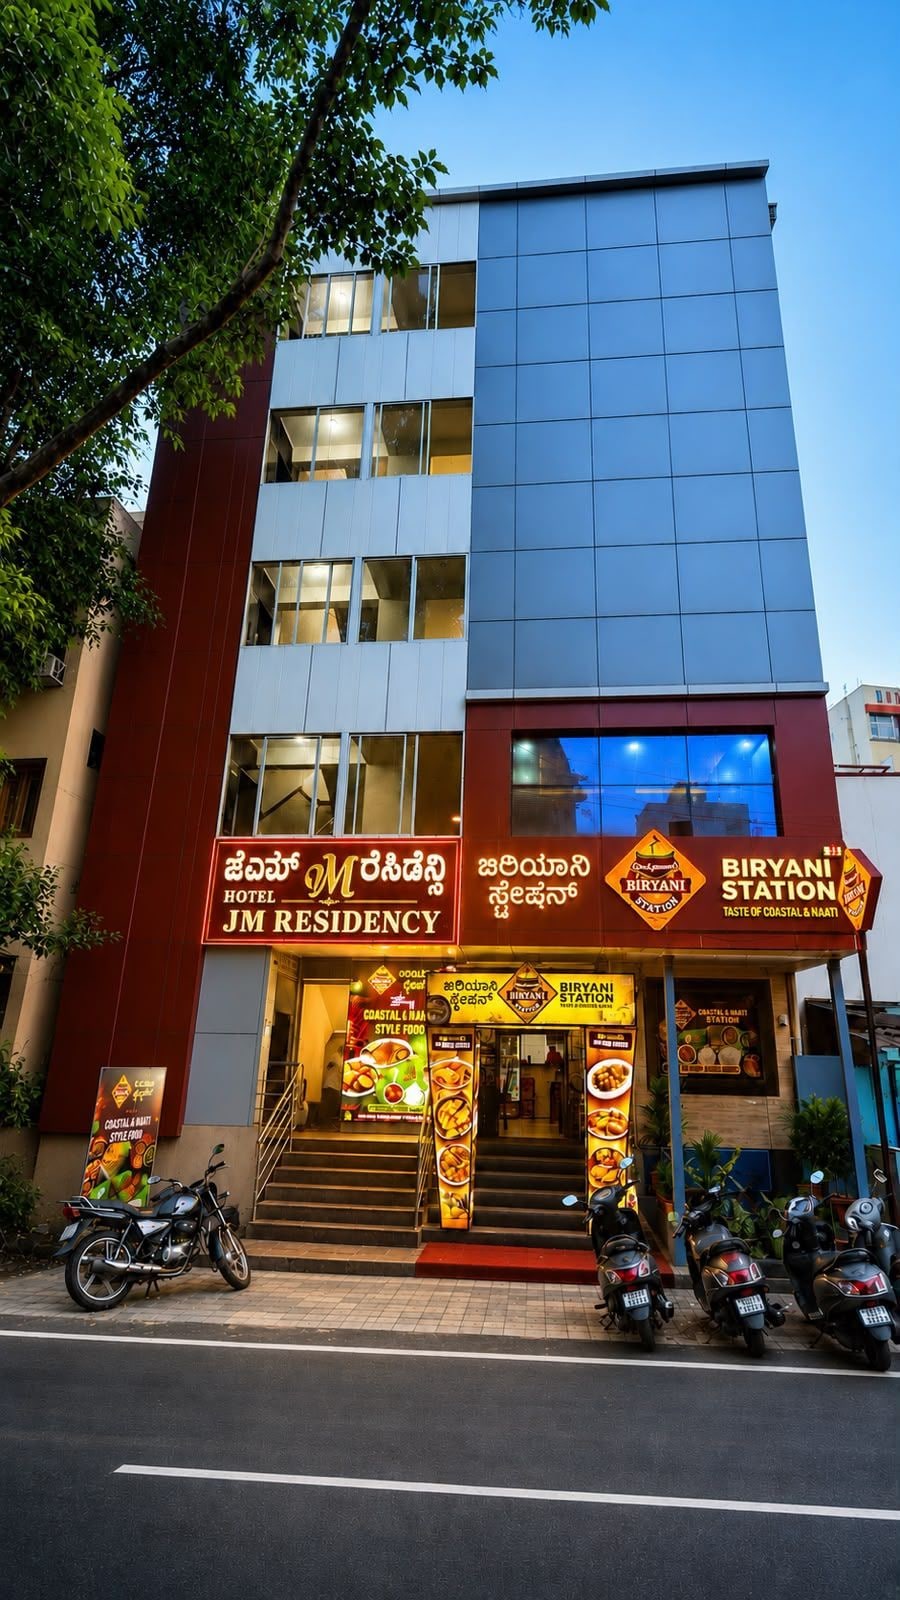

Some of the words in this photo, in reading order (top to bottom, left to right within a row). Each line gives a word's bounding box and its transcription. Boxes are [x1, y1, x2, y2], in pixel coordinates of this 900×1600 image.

[478, 853, 590, 877] ಬಿರಿಯಾನಿ
[721, 858, 832, 878] BIRYANI
[626, 879, 687, 892] BIRYANI
[722, 880, 836, 901] STATION
[223, 889, 276, 904] HOTEL
[635, 896, 679, 913] STATION
[723, 906, 750, 917] TASTE
[750, 906, 762, 917] OF
[763, 906, 803, 918] COASTAL
[803, 906, 811, 918] &
[811, 906, 839, 918] NAATI
[222, 909, 266, 933] JM
[272, 909, 442, 934] RESIDENCY
[560, 982, 614, 993] BIRYANI
[559, 993, 614, 1003] STATION
[363, 1009, 402, 1020] COASTAL
[375, 1024, 401, 1035] STYLE
